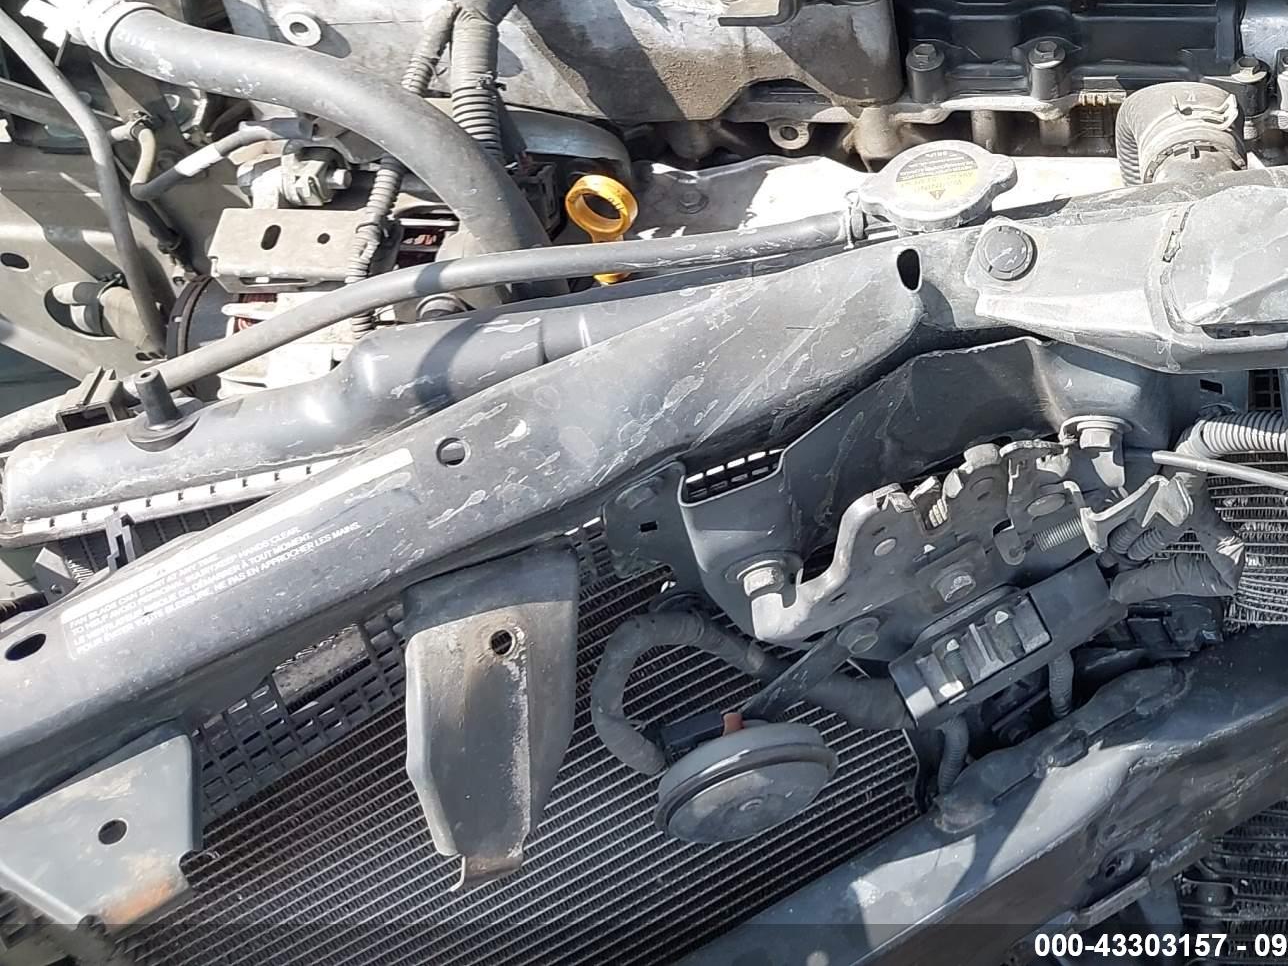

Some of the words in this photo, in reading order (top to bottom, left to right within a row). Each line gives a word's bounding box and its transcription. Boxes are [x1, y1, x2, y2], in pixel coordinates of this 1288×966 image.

[227, 571, 246, 586] PAS
[246, 565, 259, 577] EN
[260, 541, 313, 571] APPROCHER
[314, 533, 331, 547] LES
[241, 559, 248, 569] À
[248, 549, 272, 565] TOUT
[71, 624, 83, 635] TO
[238, 539, 269, 559] HANDS
